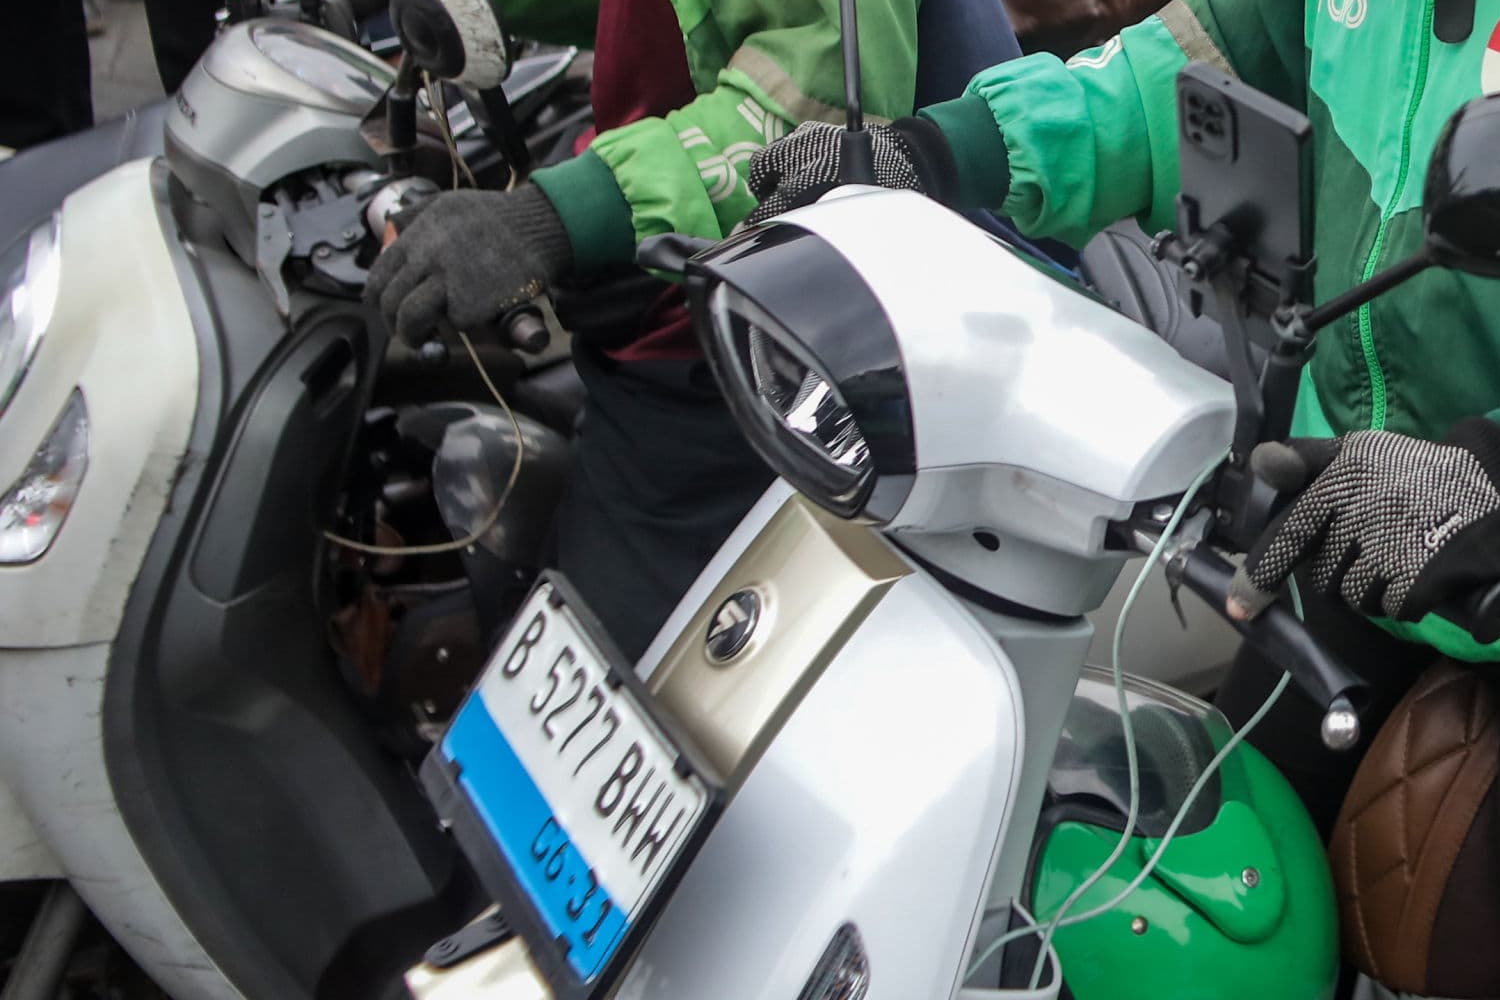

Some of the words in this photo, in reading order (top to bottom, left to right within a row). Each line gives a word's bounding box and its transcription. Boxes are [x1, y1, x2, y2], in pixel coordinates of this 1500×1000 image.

[504, 609, 547, 677] B
[530, 646, 622, 777] 5277
[595, 741, 685, 877] BWW
